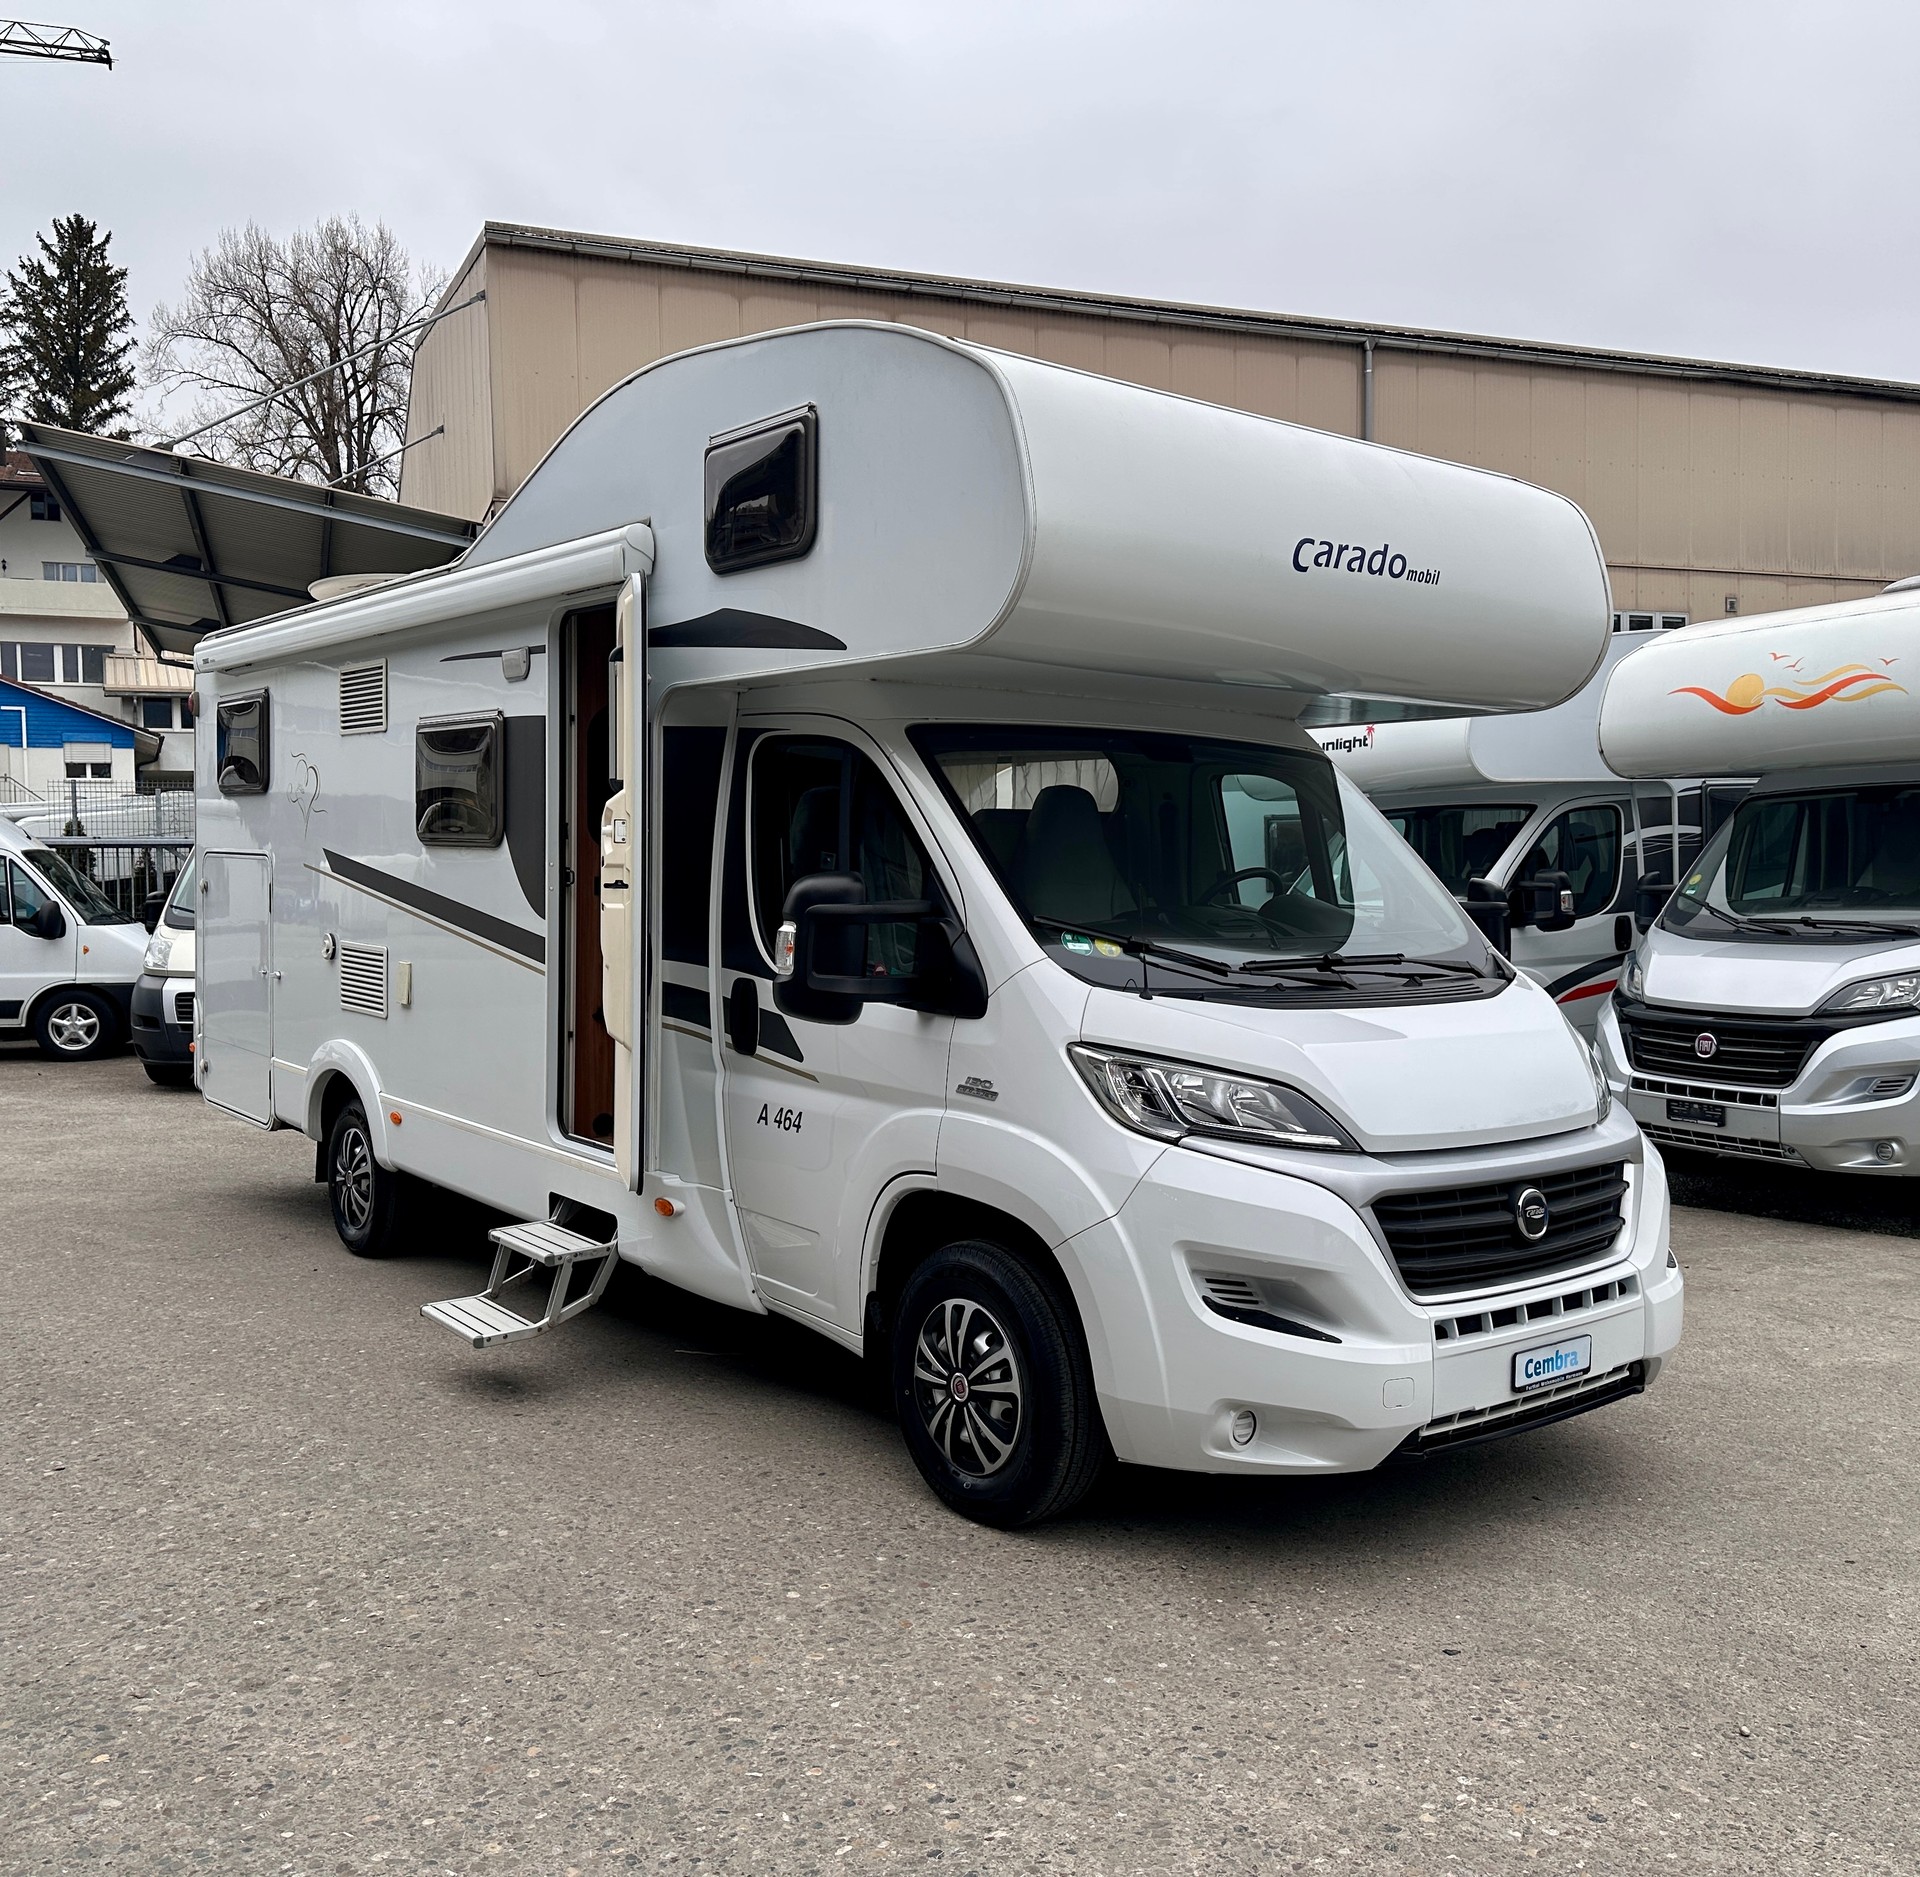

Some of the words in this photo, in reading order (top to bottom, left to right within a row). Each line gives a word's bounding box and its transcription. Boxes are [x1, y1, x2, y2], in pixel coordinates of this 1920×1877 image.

[1292, 537, 1407, 579] Carado
[1406, 568, 1441, 585] mobil
[1699, 1040, 1712, 1052] FIAT
[756, 1103, 769, 1126] A
[773, 1107, 803, 1134] 464
[1524, 1349, 1579, 1379] Cembra
